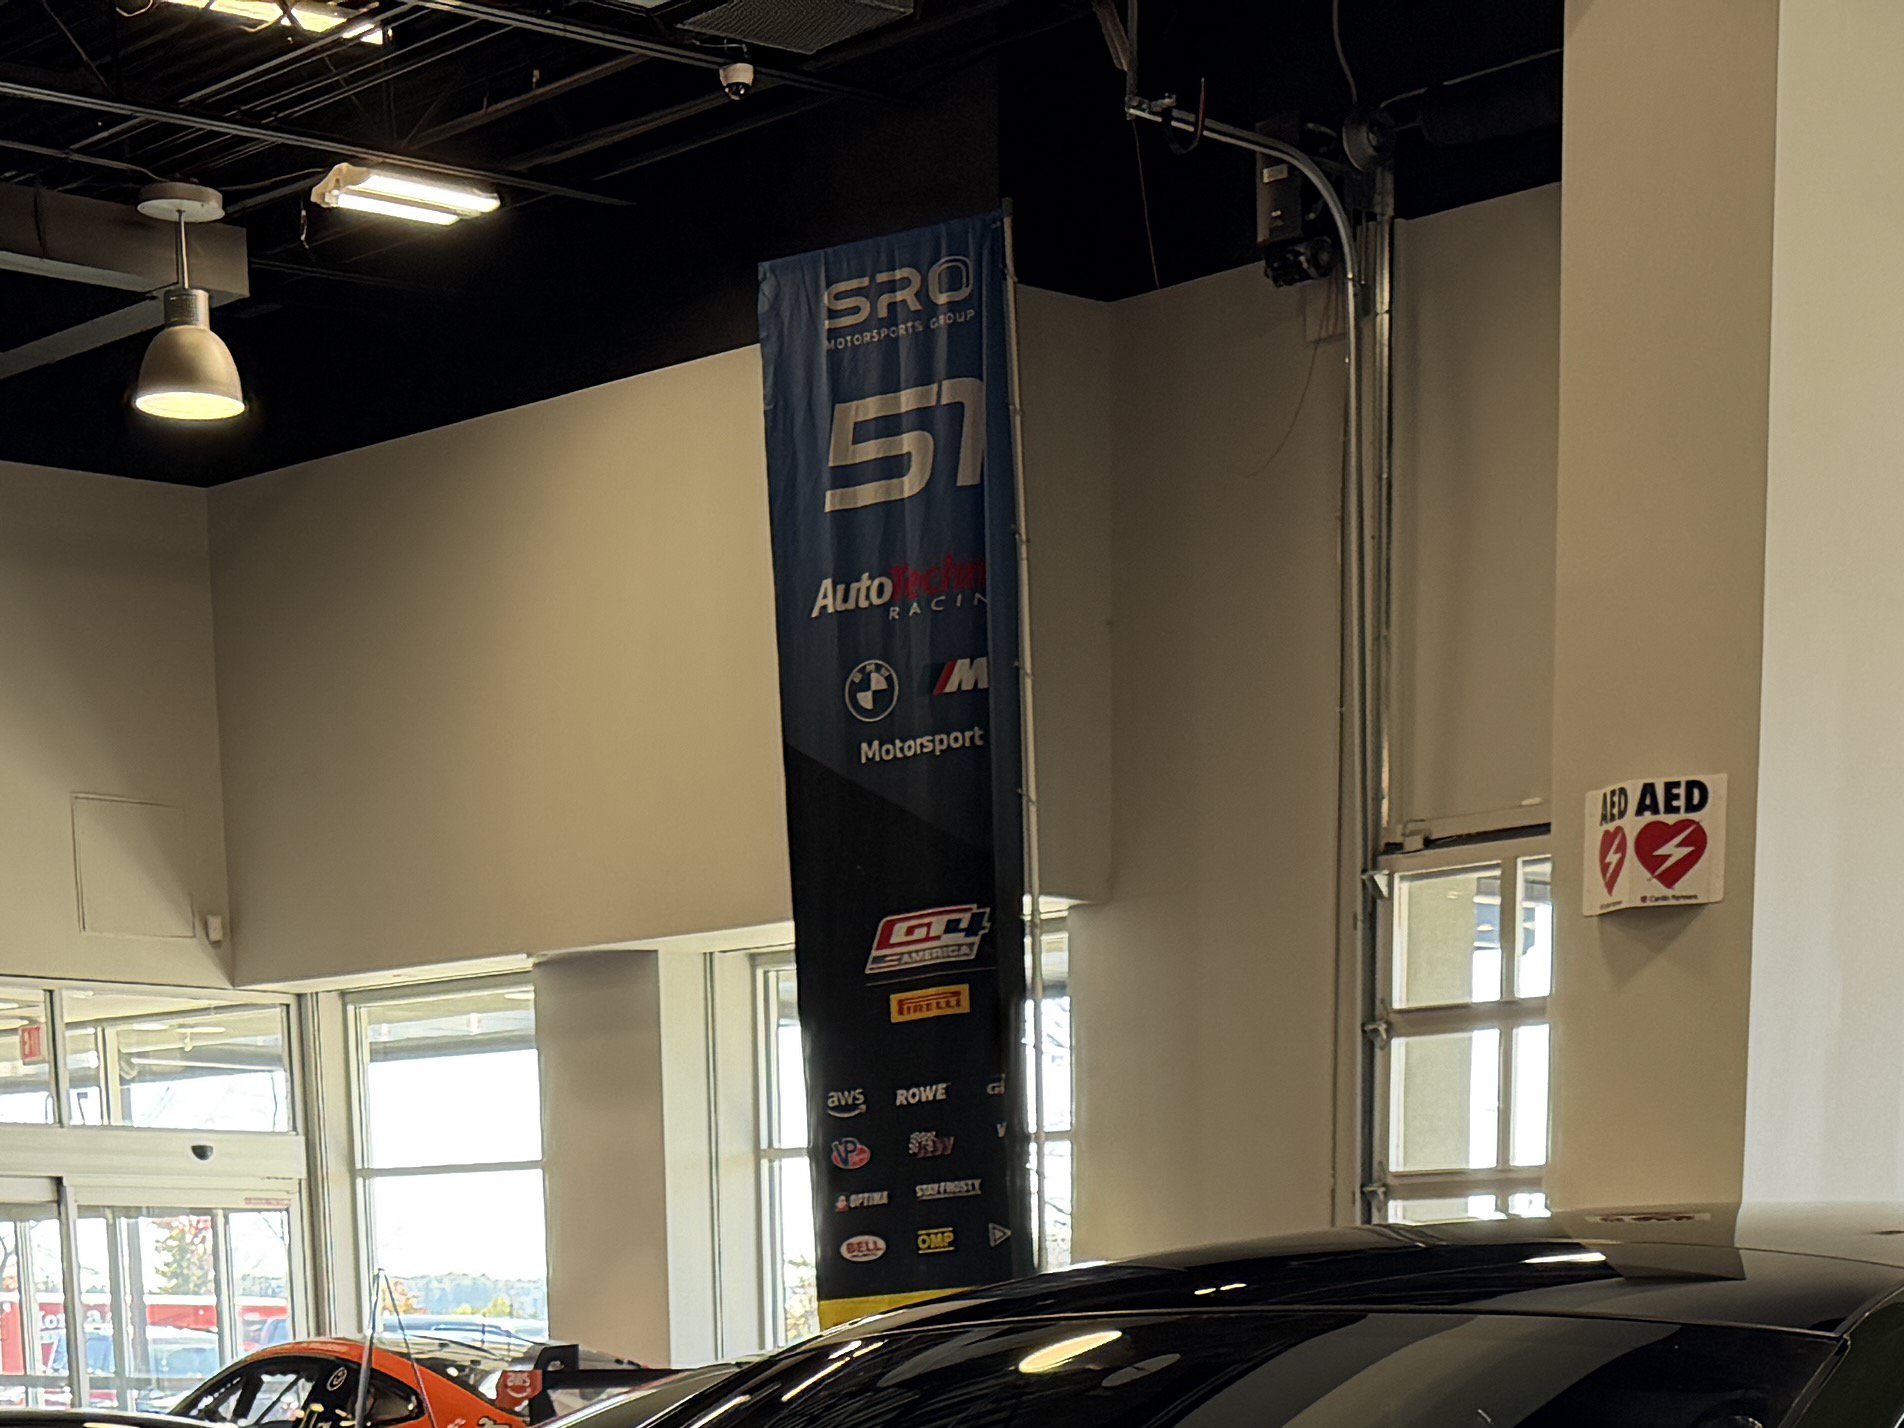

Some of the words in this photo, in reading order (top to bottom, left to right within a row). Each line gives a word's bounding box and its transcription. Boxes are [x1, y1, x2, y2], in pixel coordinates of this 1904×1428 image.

[824, 255, 973, 329] SRO
[825, 320, 924, 351] MOTORSPORTS
[930, 309, 976, 329] GROUP
[824, 377, 985, 513] 51
[860, 726, 985, 764] Motorsport
[1600, 786, 1628, 826] AED
[1635, 780, 1709, 817] AED
[889, 909, 988, 945] GT4
[900, 944, 972, 964] AMERICA
[897, 990, 962, 1015] PIRELLI
[827, 1088, 865, 1108] aws
[896, 1082, 948, 1106] ROWE
[847, 1240, 884, 1254] BELL
[917, 1231, 955, 1249] OMP
